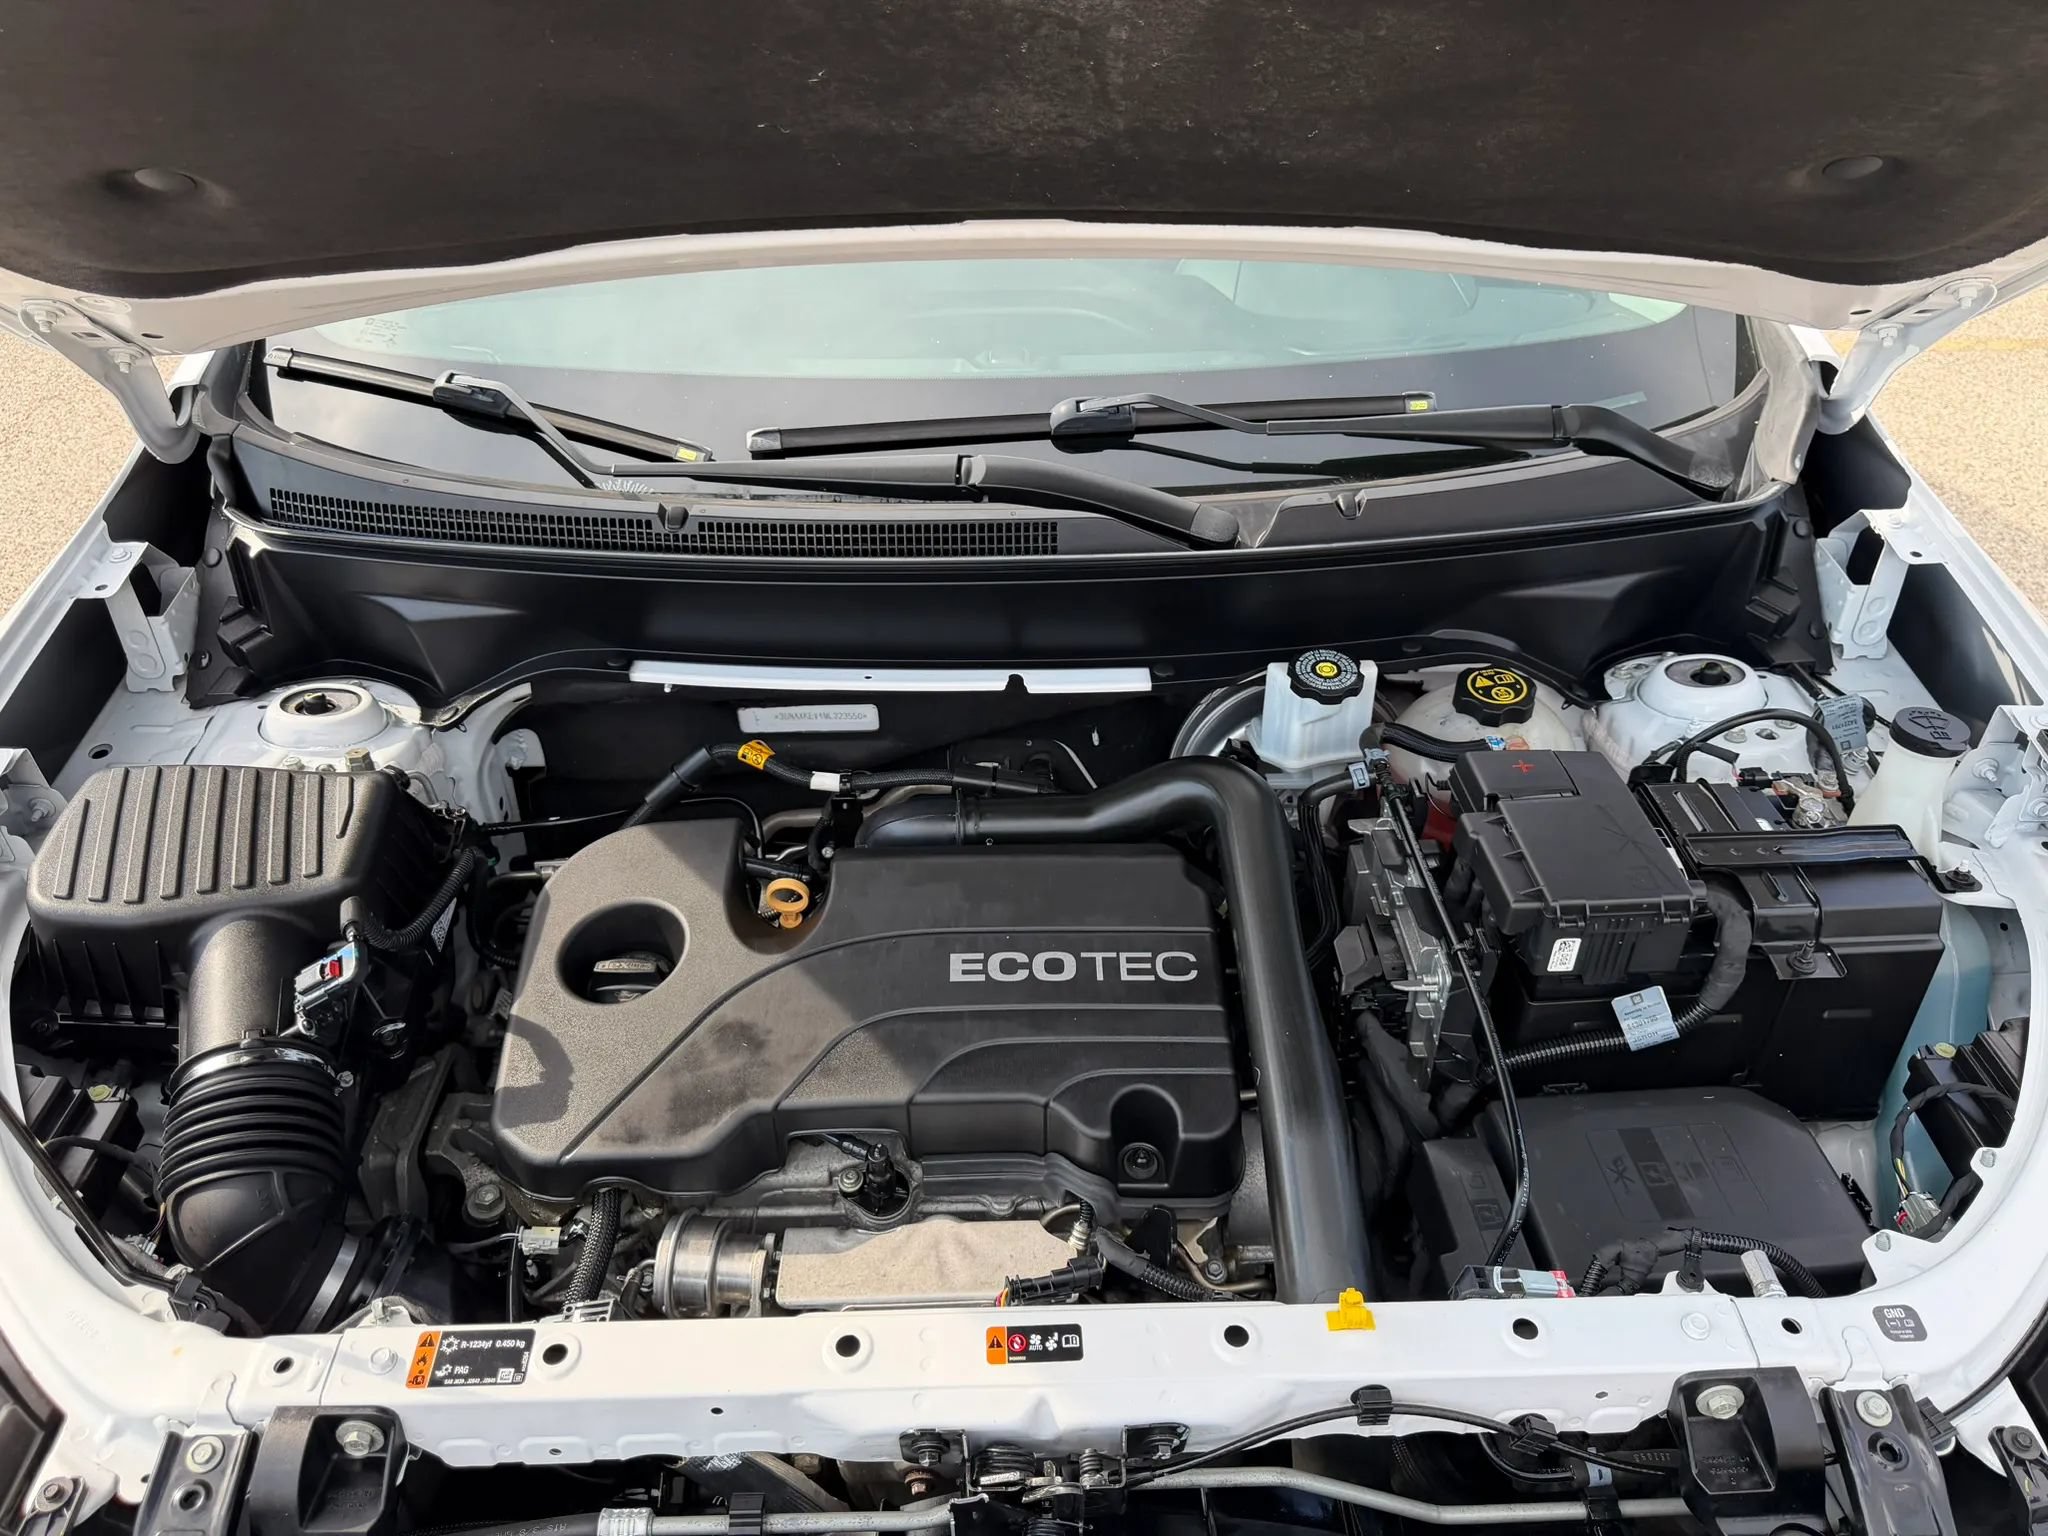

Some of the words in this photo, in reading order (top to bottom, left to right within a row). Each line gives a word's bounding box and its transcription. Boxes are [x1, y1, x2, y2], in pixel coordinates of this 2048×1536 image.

[949, 951, 1199, 982] ECOTEC
[1884, 1308, 1905, 1318] GND
[460, 1340, 493, 1349] R-1234yf
[496, 1340, 515, 1348] 0.450
[516, 1340, 526, 1349] kg
[454, 1366, 470, 1374] PAG
